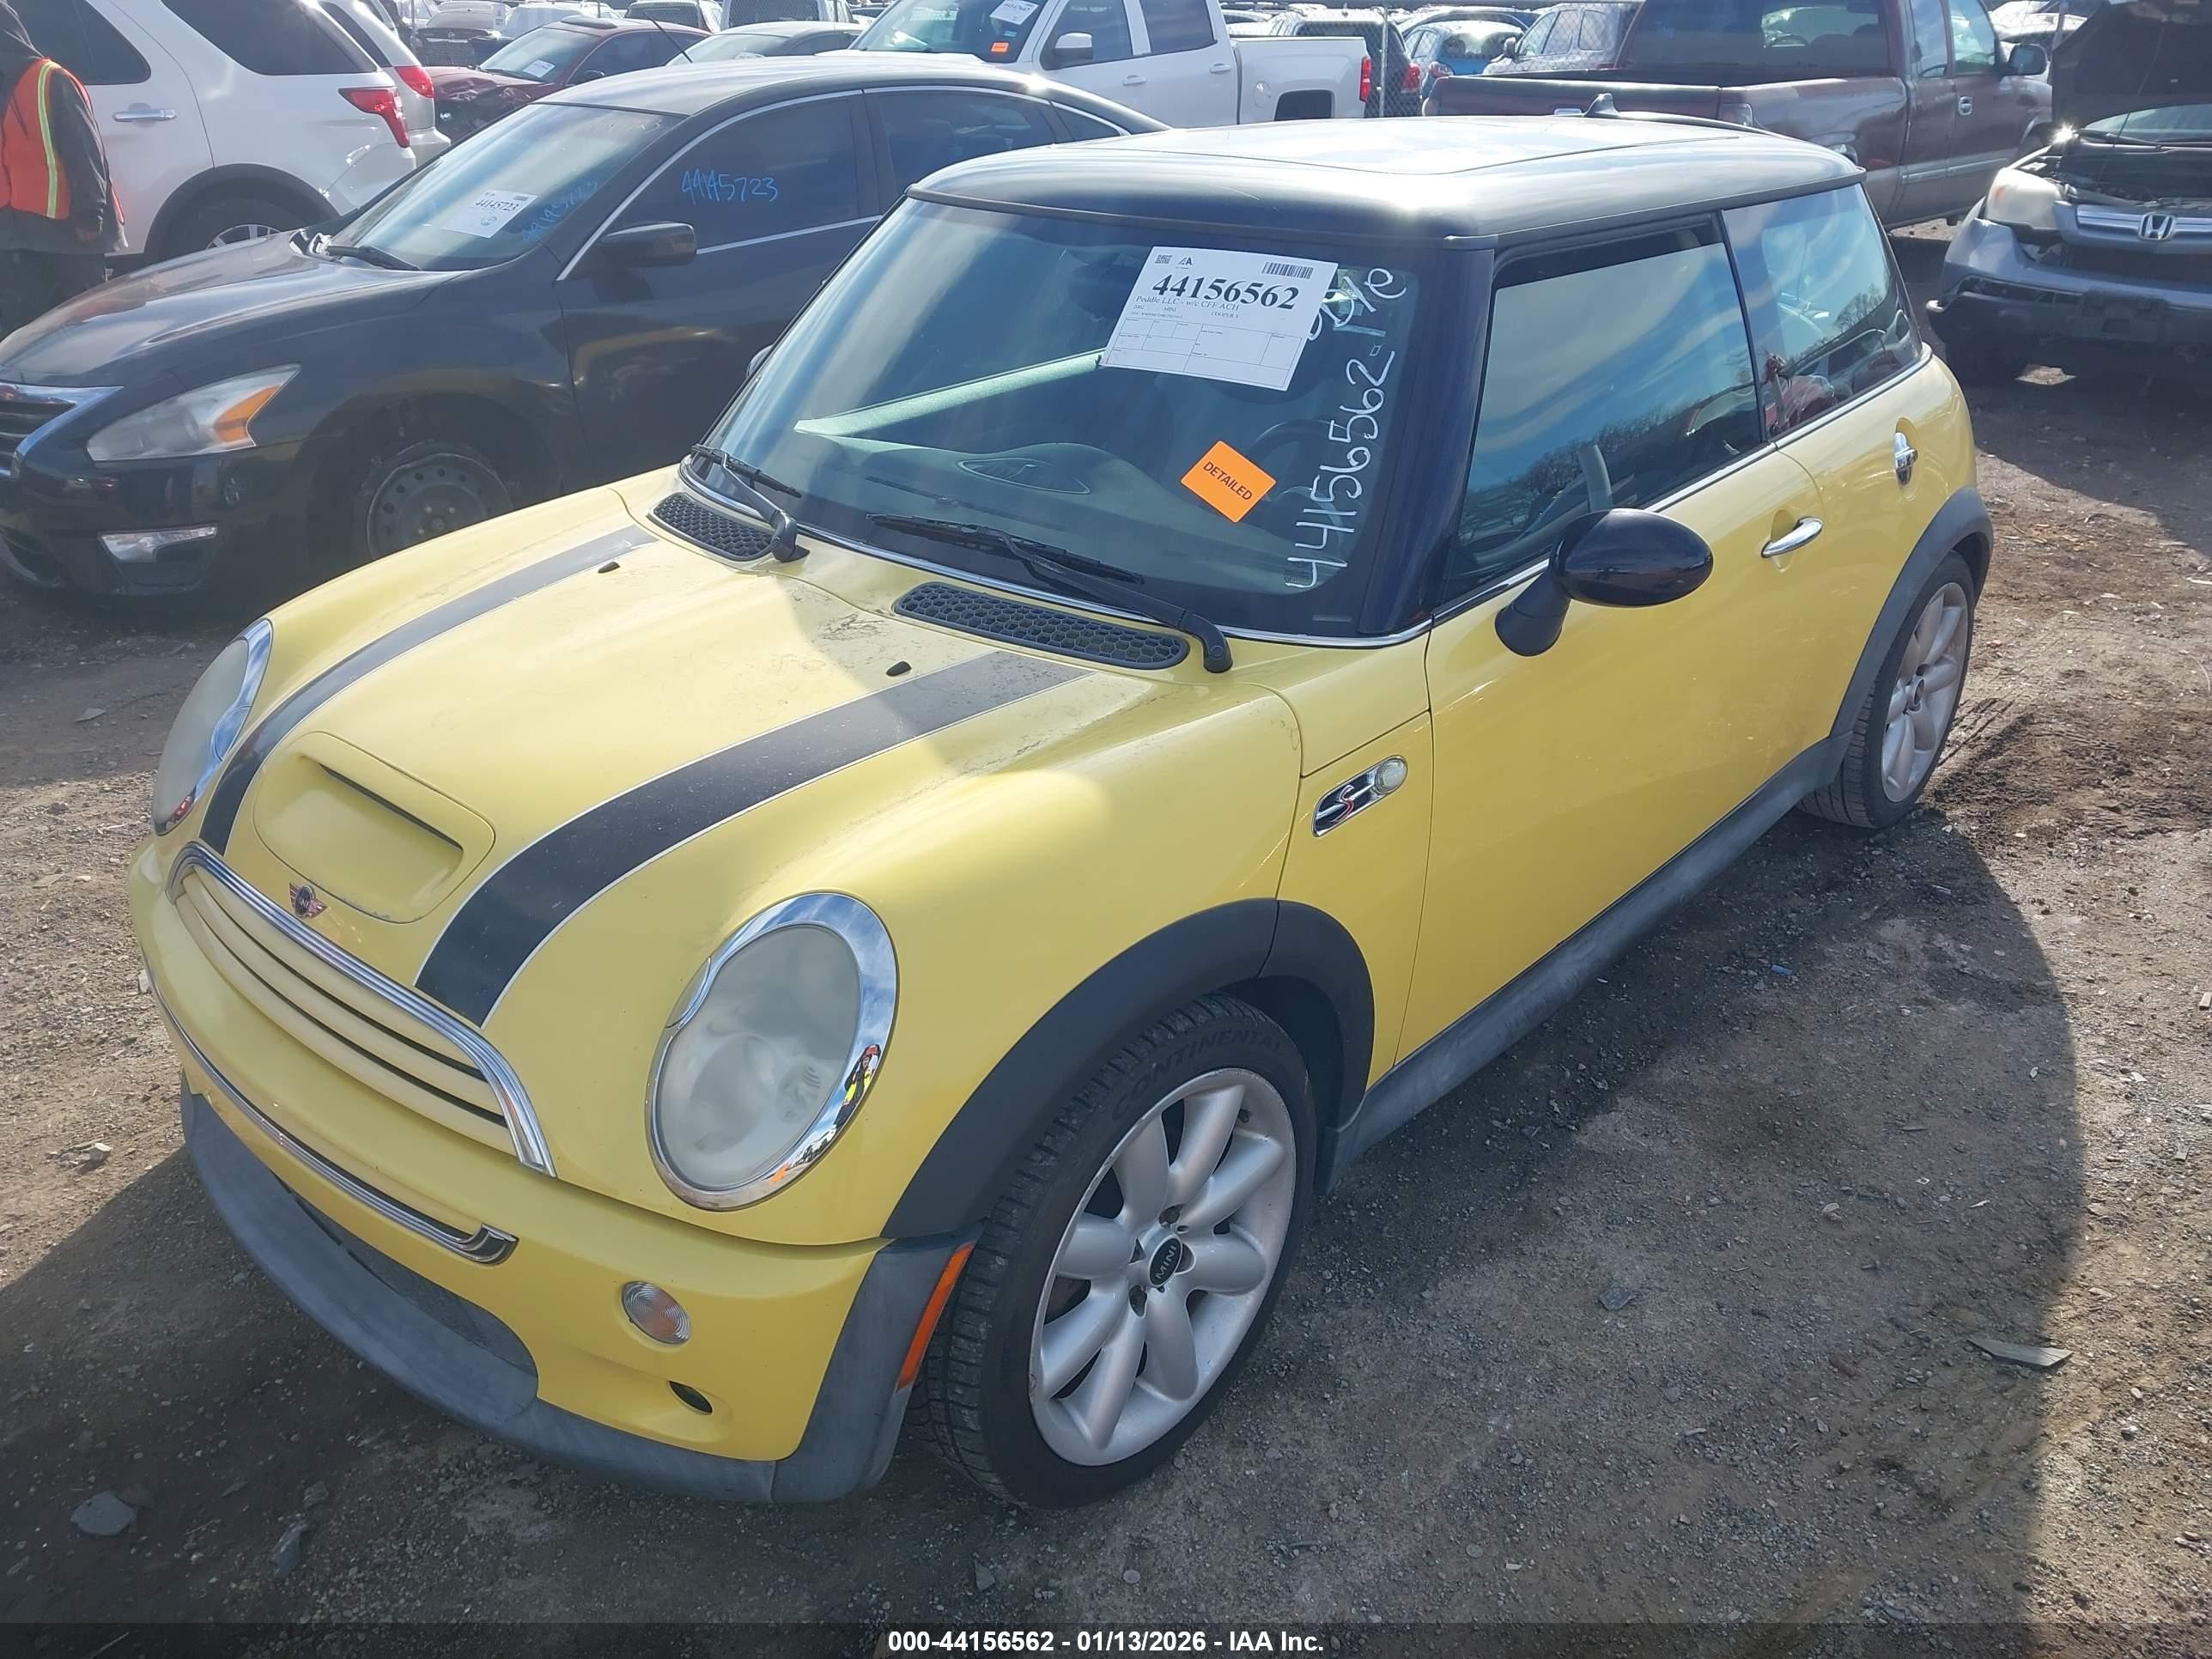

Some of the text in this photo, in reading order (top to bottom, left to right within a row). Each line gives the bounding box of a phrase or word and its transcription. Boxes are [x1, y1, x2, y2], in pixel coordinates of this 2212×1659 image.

[681, 168, 778, 205] 44145723
[1136, 295, 1161, 304] Peddle
[1162, 296, 1181, 305] LLC
[1152, 274, 1299, 310] 44156562
[1202, 461, 1253, 501] DETAILED
[1154, 1245, 1177, 1279] MINI
